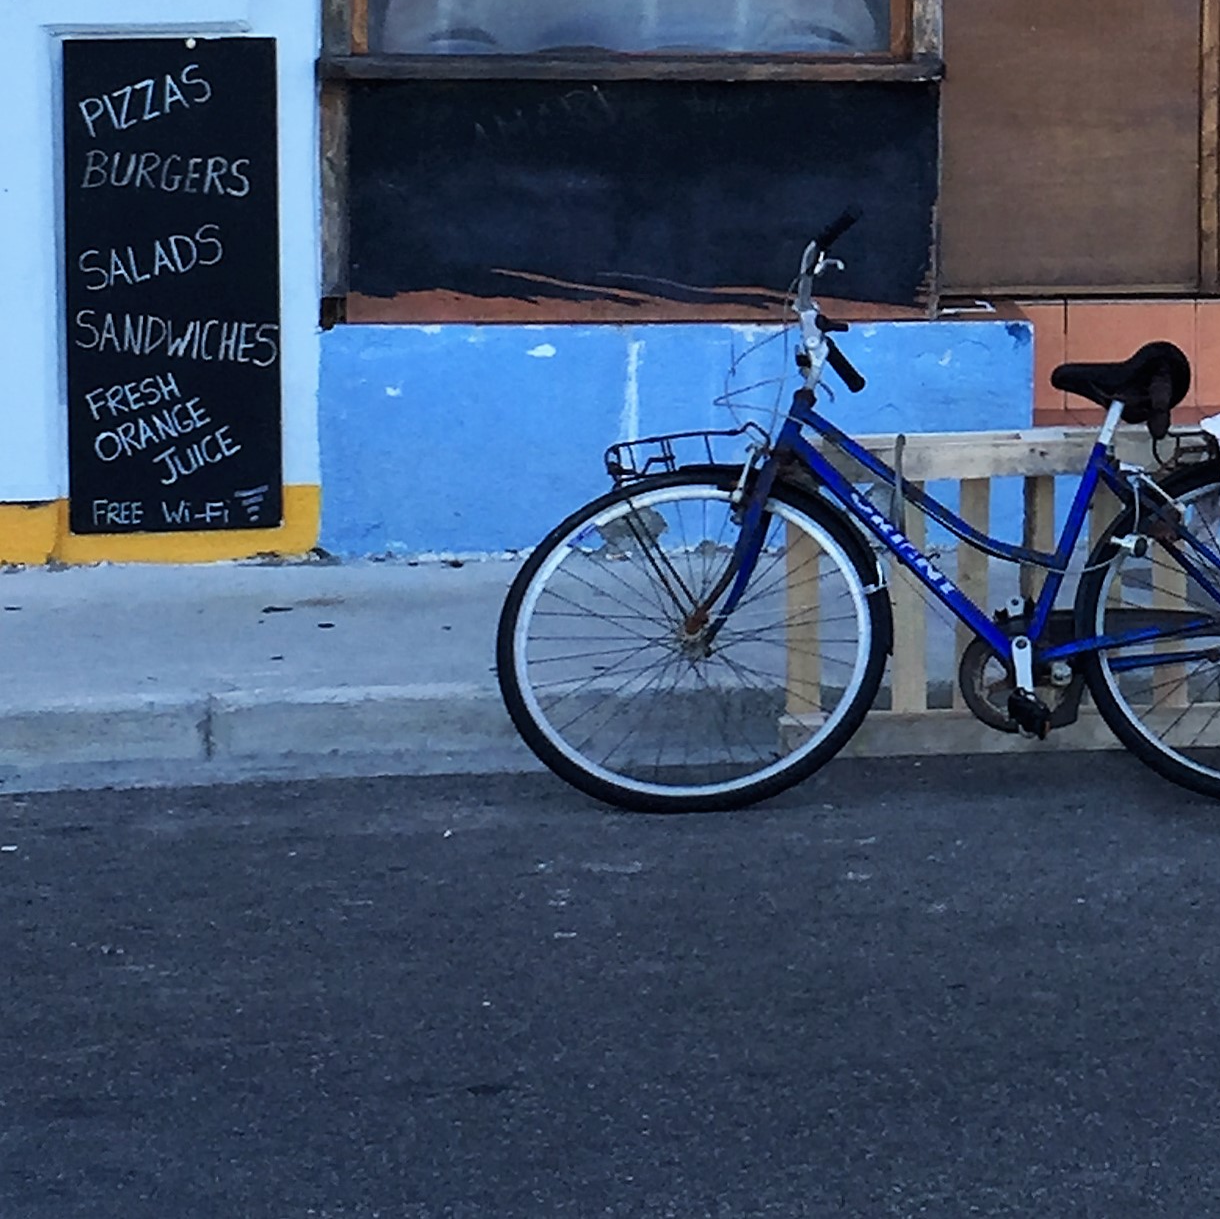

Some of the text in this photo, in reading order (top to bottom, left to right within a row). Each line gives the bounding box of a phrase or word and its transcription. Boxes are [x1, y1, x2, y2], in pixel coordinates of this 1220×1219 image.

[78, 64, 212, 138] PIZZAS
[81, 149, 251, 198] BURGERS
[79, 224, 223, 291] SALADS
[75, 309, 279, 367] SANDWICHES
[85, 372, 182, 421] FRESH
[94, 397, 211, 462] ORANGE
[152, 425, 242, 485] JUICE
[92, 499, 144, 525] FREE
